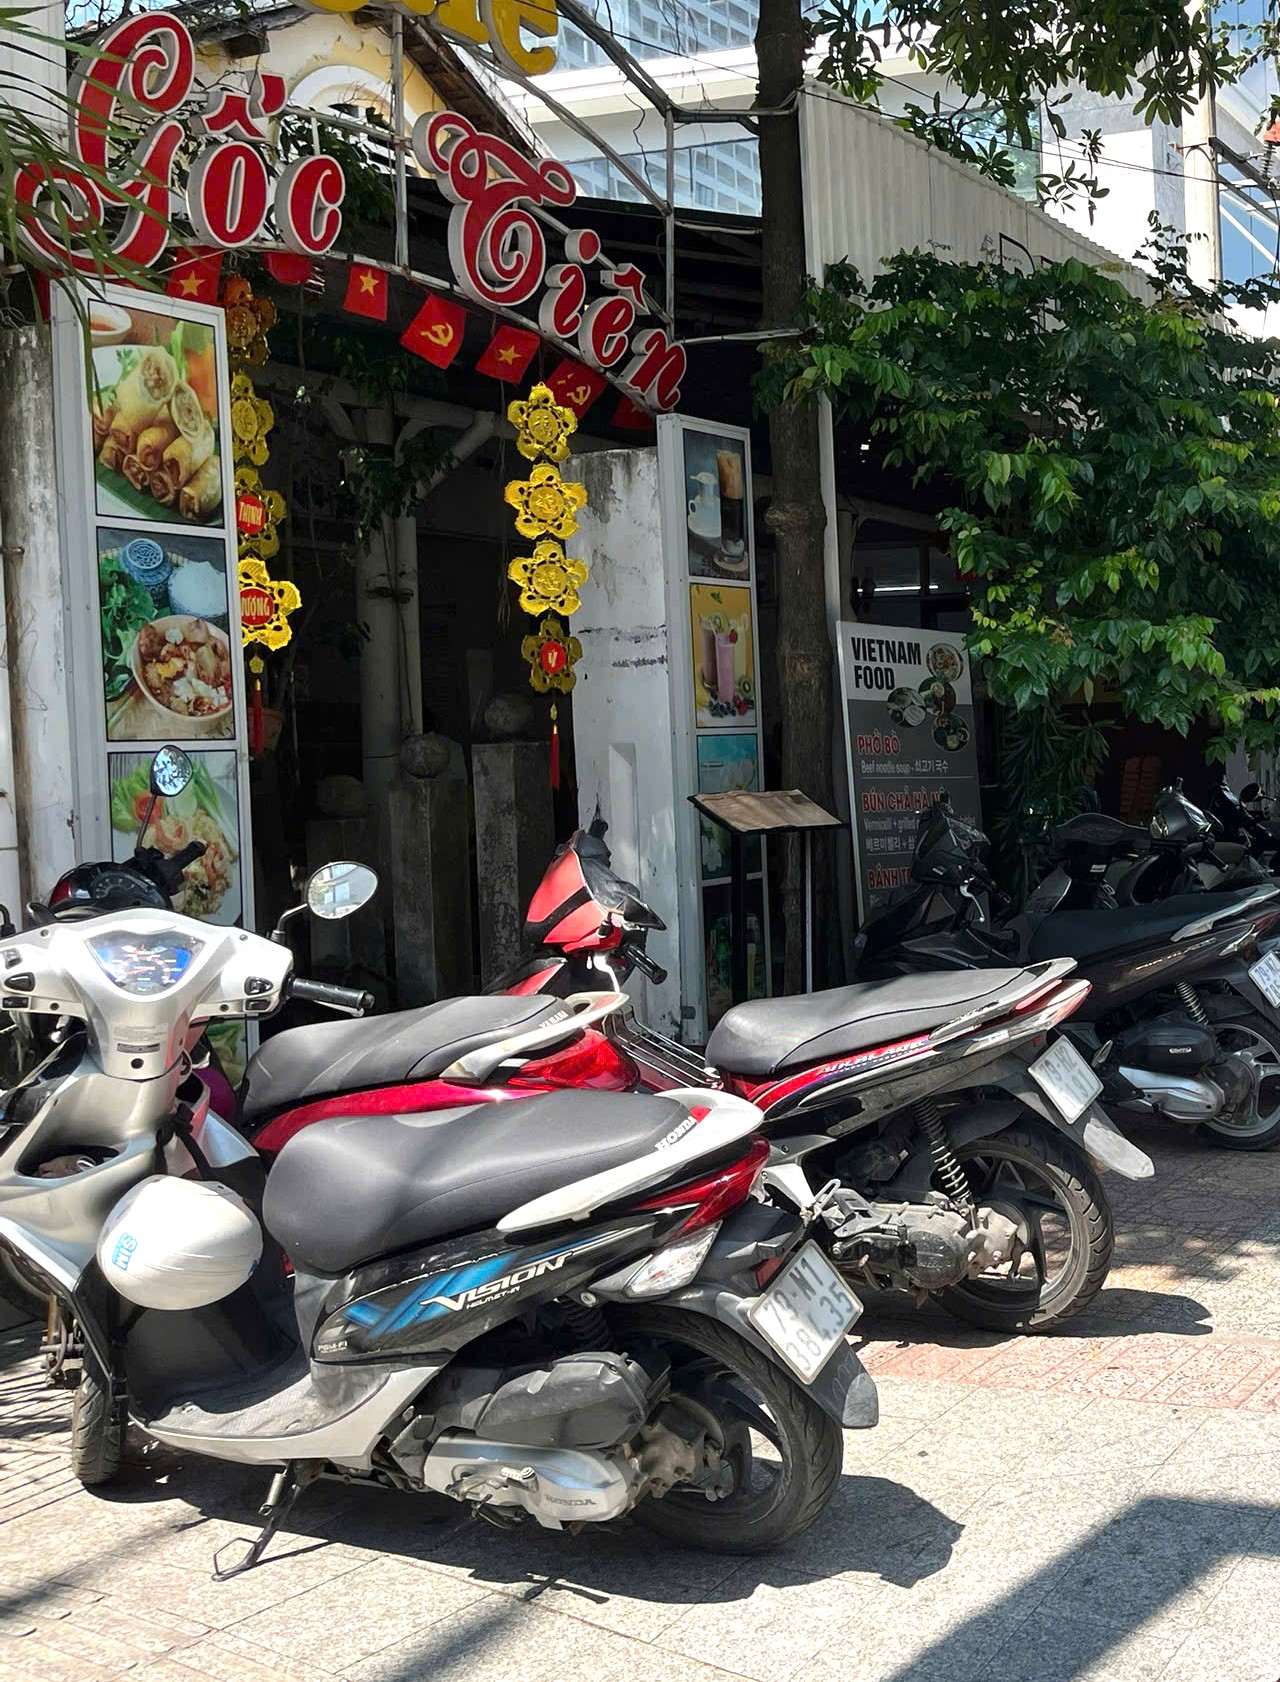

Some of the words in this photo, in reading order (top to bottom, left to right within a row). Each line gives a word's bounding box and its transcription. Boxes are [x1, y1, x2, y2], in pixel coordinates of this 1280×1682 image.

[851, 636, 922, 665] VIETNAM
[854, 665, 896, 690] FOOD
[419, 1251, 575, 1312] VISION
